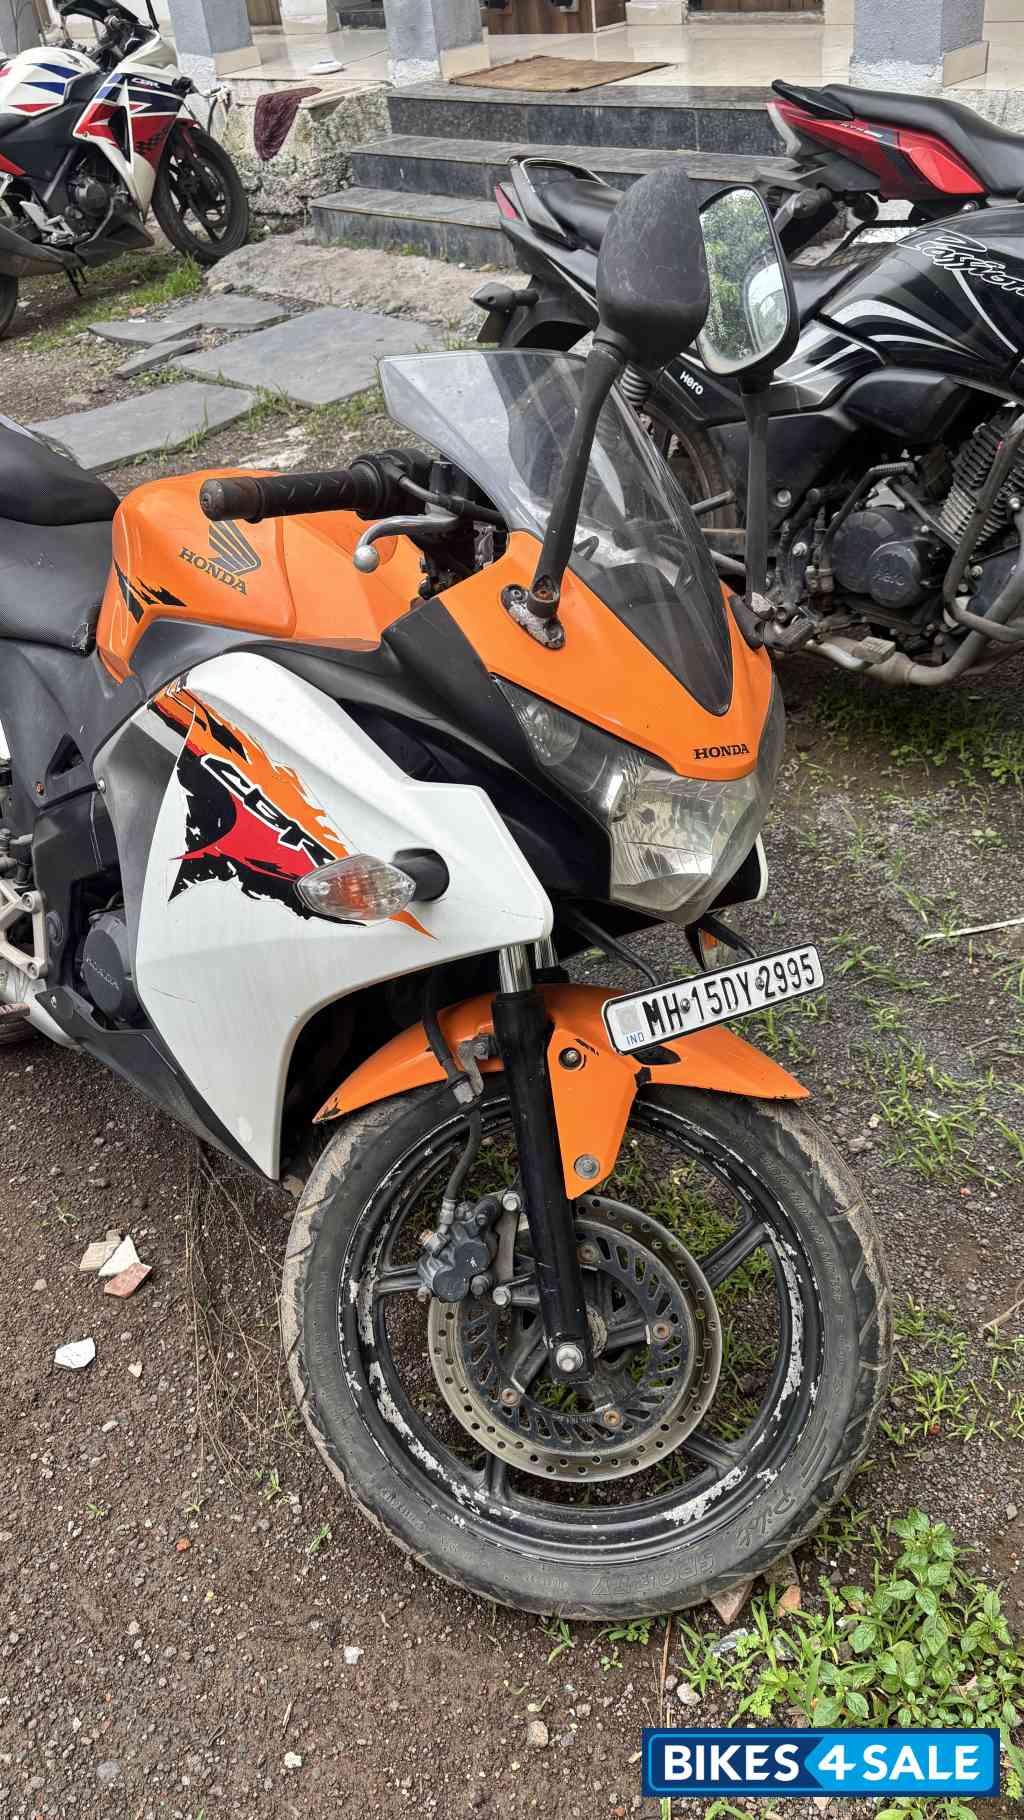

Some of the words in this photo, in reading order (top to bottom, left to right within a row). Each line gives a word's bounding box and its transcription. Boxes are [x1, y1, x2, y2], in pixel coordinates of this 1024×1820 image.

[680, 371, 704, 395] Hero
[179, 546, 247, 596] HONDA
[693, 743, 750, 760] HONDA
[201, 753, 338, 869] CBR
[642, 992, 684, 1037] MH
[757, 953, 815, 999] 2995
[626, 1032, 645, 1045] IND
